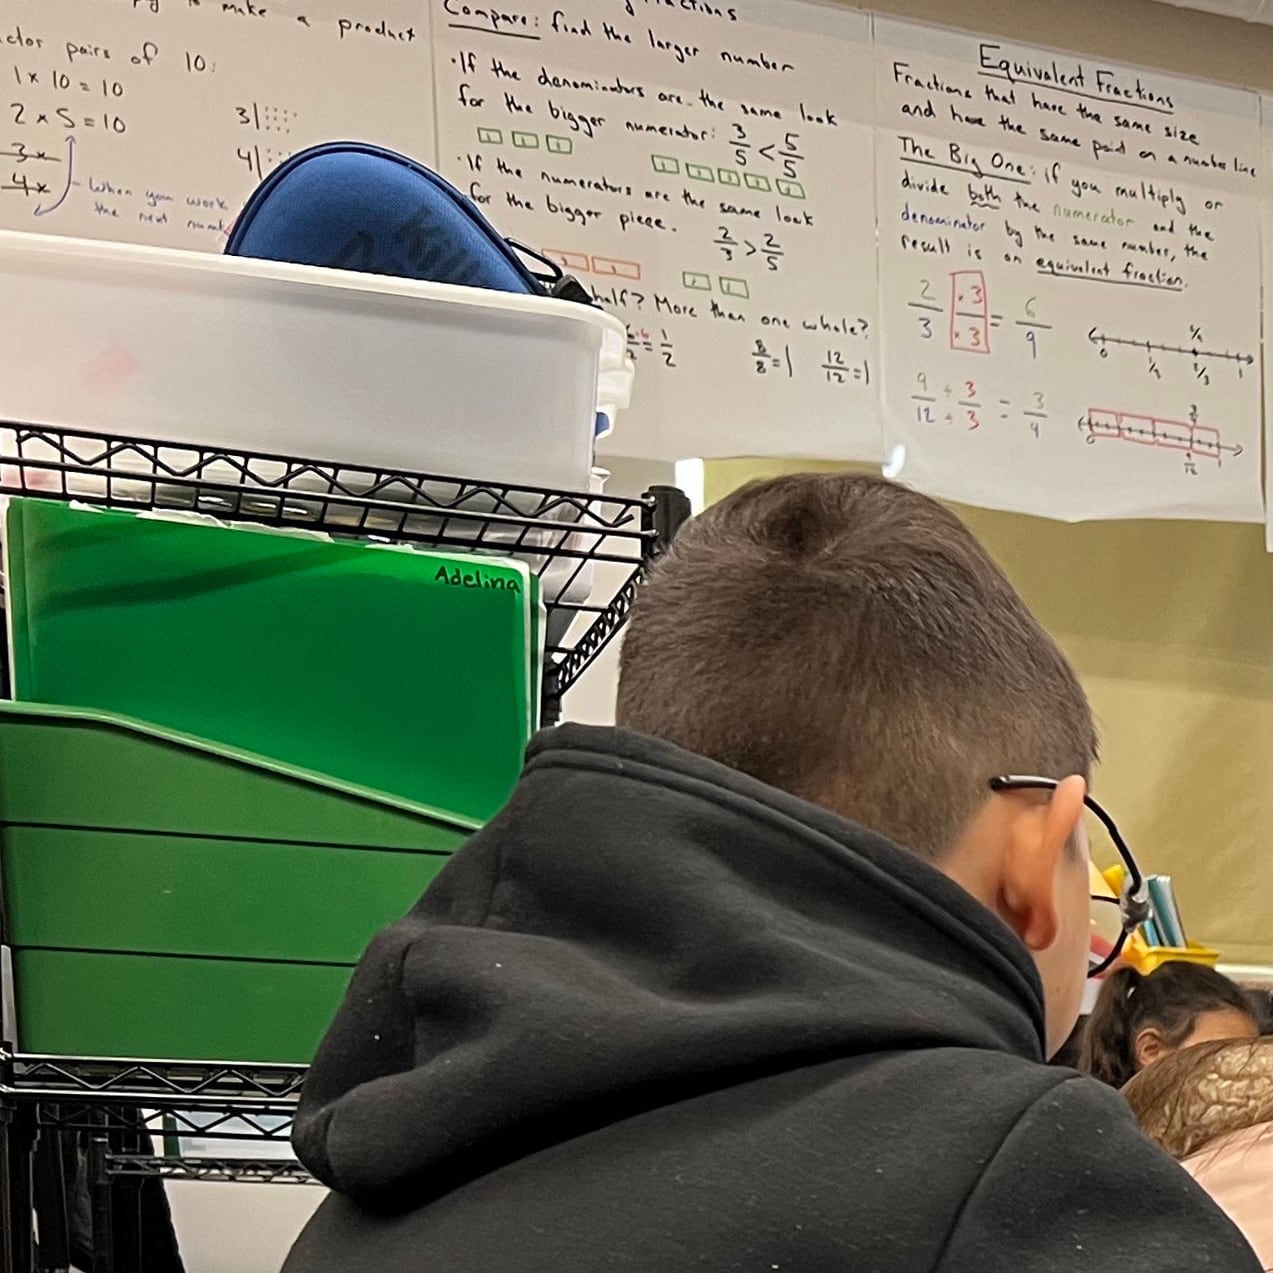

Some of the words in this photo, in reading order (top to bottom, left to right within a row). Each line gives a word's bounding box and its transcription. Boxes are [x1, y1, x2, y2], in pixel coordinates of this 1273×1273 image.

[66, 41, 111, 62] pairs
[131, 41, 158, 66] of
[338, 18, 416, 42] product
[552, 11, 592, 37] find
[603, 21, 632, 44] the
[648, 28, 700, 64] larger
[721, 52, 795, 73] number
[491, 57, 521, 81] the
[538, 66, 645, 98] denominators
[658, 91, 684, 106] are
[699, 88, 724, 111] the
[741, 104, 782, 120] same
[800, 102, 838, 128] look
[893, 61, 972, 99] Fractions
[985, 84, 1016, 105] that
[1032, 92, 1067, 116] have
[1076, 102, 1102, 125] the
[1114, 115, 1151, 134] same
[1165, 126, 1200, 146] size
[979, 43, 1085, 88] Equivalent
[1096, 70, 1174, 109] Fractions
[458, 84, 485, 108] for
[504, 92, 534, 114] the
[548, 100, 606, 138] bigger
[902, 99, 936, 118] and
[951, 104, 986, 127] have
[998, 114, 1027, 135] the
[1040, 128, 1081, 147] same
[1234, 157, 1256, 178] line
[470, 181, 492, 205] for
[506, 191, 535, 211] the
[546, 194, 602, 226] bigger
[497, 157, 523, 180] the
[541, 171, 632, 196] numerators
[645, 189, 671, 203] are
[682, 189, 705, 210] the
[719, 201, 761, 220] same
[776, 205, 814, 227] look
[898, 135, 935, 159] The
[950, 142, 983, 179] Big
[1071, 178, 1101, 198] you
[1116, 182, 1187, 216] multiply
[1204, 200, 1224, 210] or
[901, 169, 949, 196] divide
[968, 183, 1002, 203] both
[1014, 191, 1041, 213] the
[1053, 203, 1136, 227] numerator
[1153, 219, 1175, 234] and
[1188, 223, 1215, 242] the
[901, 202, 985, 232] denominator
[1005, 220, 1023, 248] by
[1034, 225, 1055, 242] the
[1073, 234, 1108, 250] same
[1184, 243, 1208, 261] the
[901, 234, 950, 255] result
[967, 243, 982, 260] is
[1036, 254, 1110, 276] equivalent
[653, 293, 698, 319] More
[711, 300, 746, 322] than
[761, 315, 790, 329] one
[802, 314, 869, 340] whole?
[434, 565, 521, 593] Adelina
